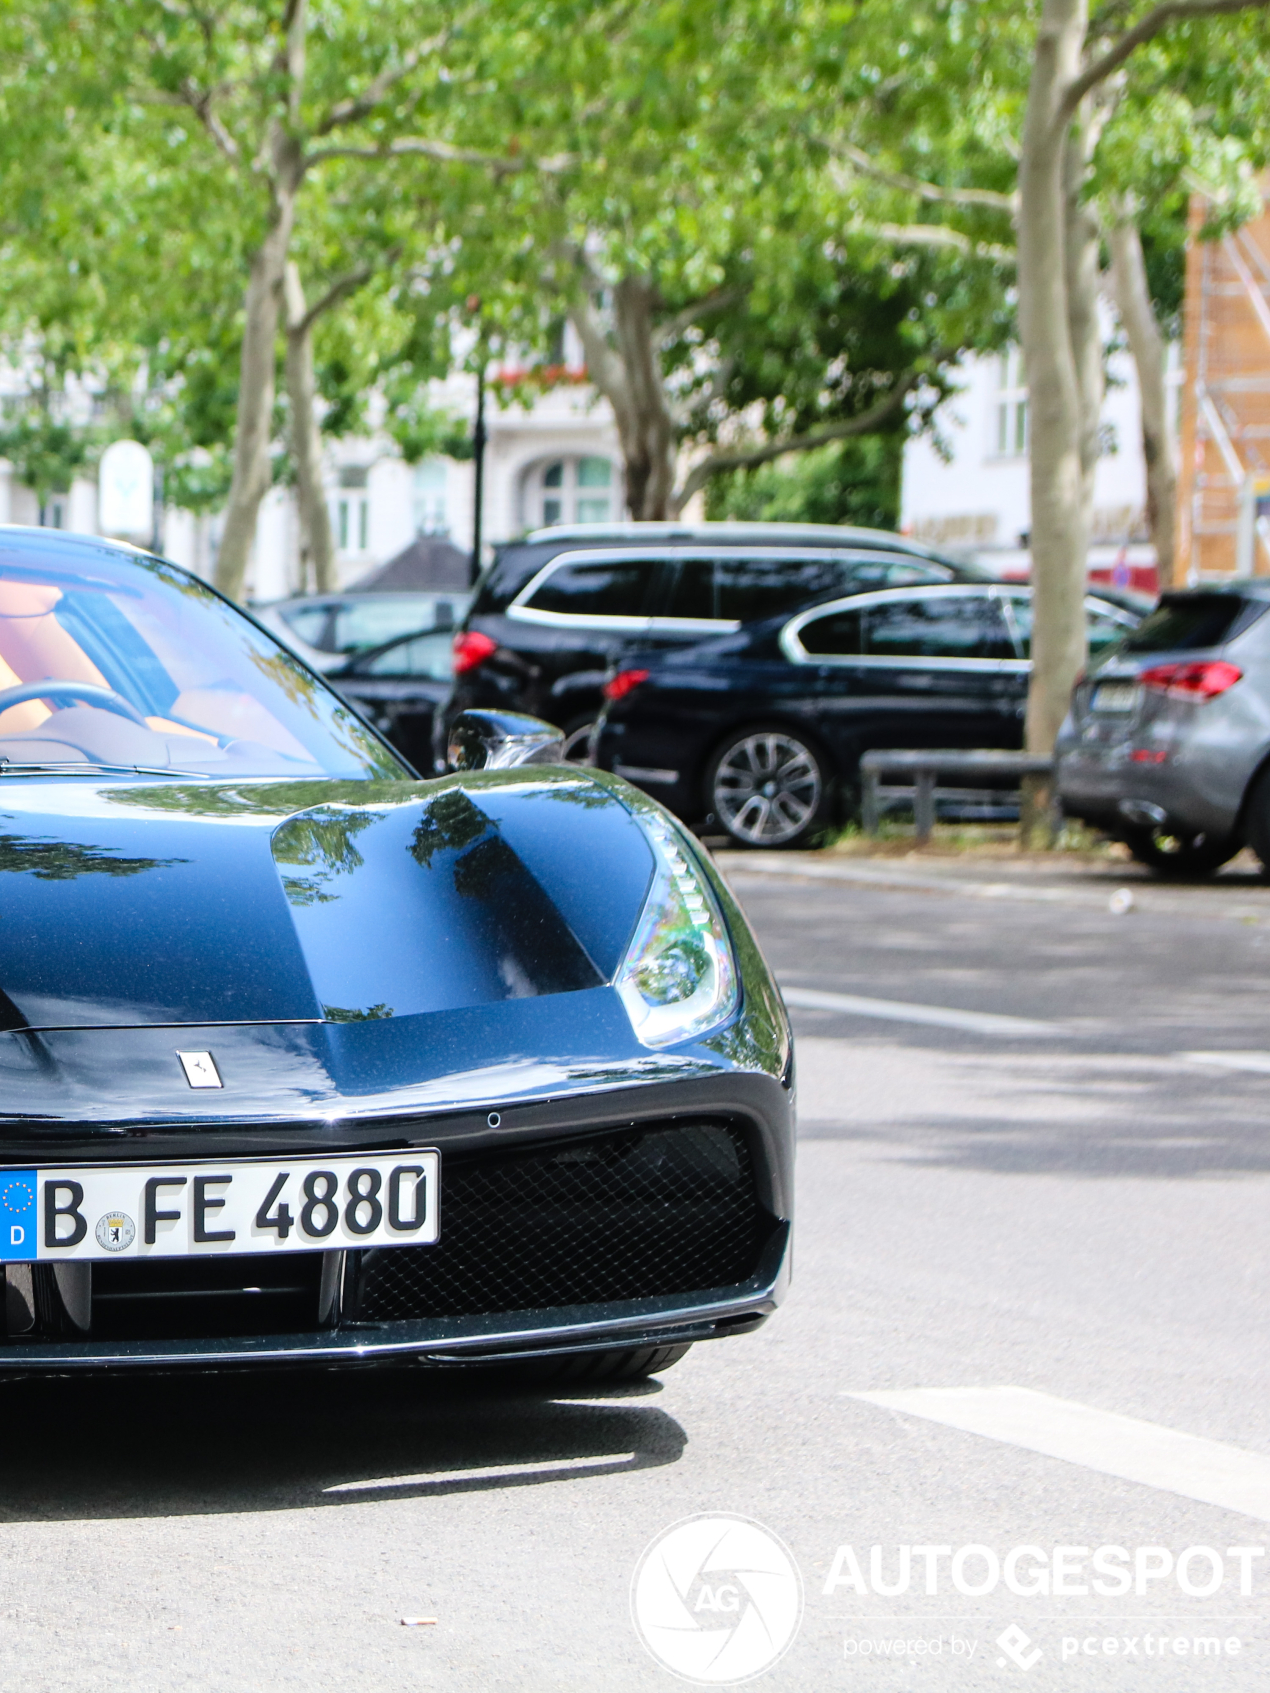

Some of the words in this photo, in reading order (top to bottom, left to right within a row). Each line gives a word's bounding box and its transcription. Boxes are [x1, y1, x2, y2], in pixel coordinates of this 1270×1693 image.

[45, 1179, 87, 1247] B
[145, 1175, 236, 1244] FE
[256, 1165, 426, 1238] 4880
[10, 1226, 25, 1244] D
